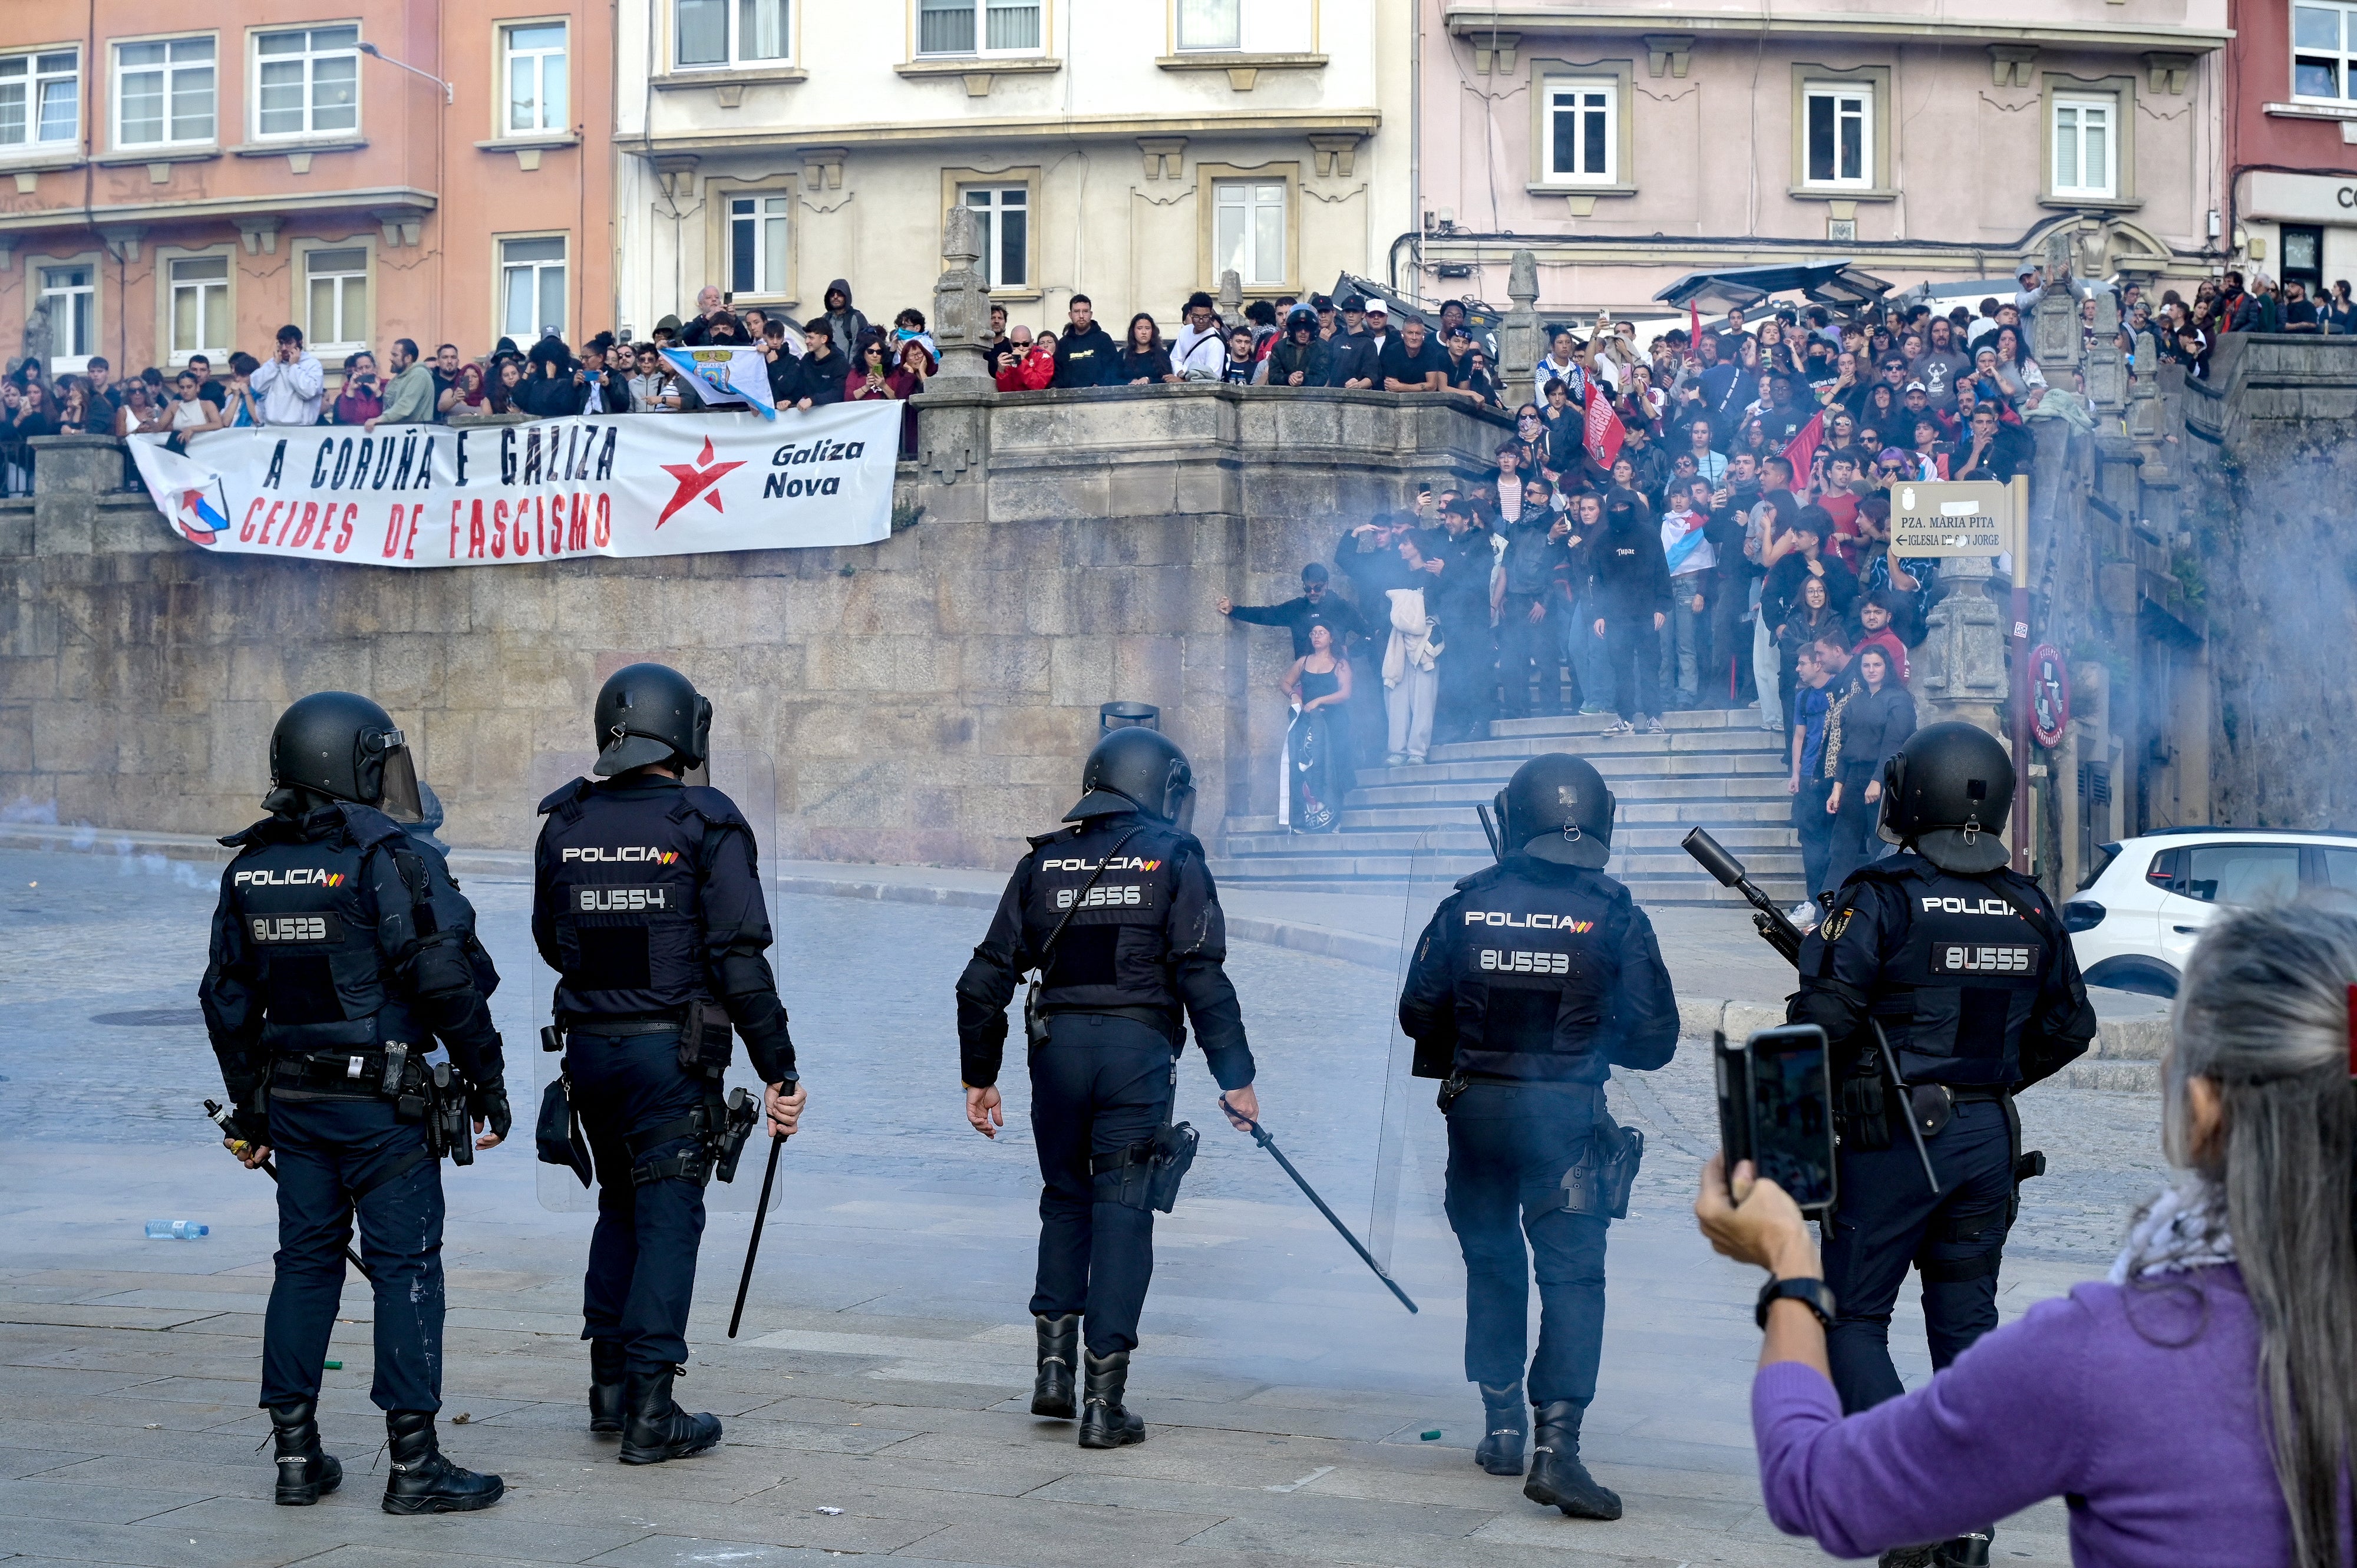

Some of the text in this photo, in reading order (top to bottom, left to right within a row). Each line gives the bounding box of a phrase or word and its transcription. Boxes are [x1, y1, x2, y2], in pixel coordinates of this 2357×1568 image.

[263, 425, 617, 490] A CORUÑA E GALIZA
[773, 439, 865, 466] Galiza
[764, 472, 840, 499] Nova
[382, 504, 424, 559] DE
[449, 492, 610, 559] FASCISMO
[1902, 517, 1995, 528] PZA. MARIA PITA
[1908, 534, 1939, 546] IGLESIA
[1972, 534, 1999, 546] JORGE
[1616, 548, 1635, 556] Tupac
[2040, 648, 2058, 661] EXCEPTO
[562, 846, 661, 863] POLICIA
[235, 868, 326, 887] POLICIA
[580, 889, 665, 910] 8U554
[1057, 885, 1141, 909] 8U556
[253, 917, 326, 940] 8U523
[1465, 911, 1576, 929] POLICIA
[1480, 949, 1570, 974] 8U553
[1945, 946, 2029, 970] 8U555
